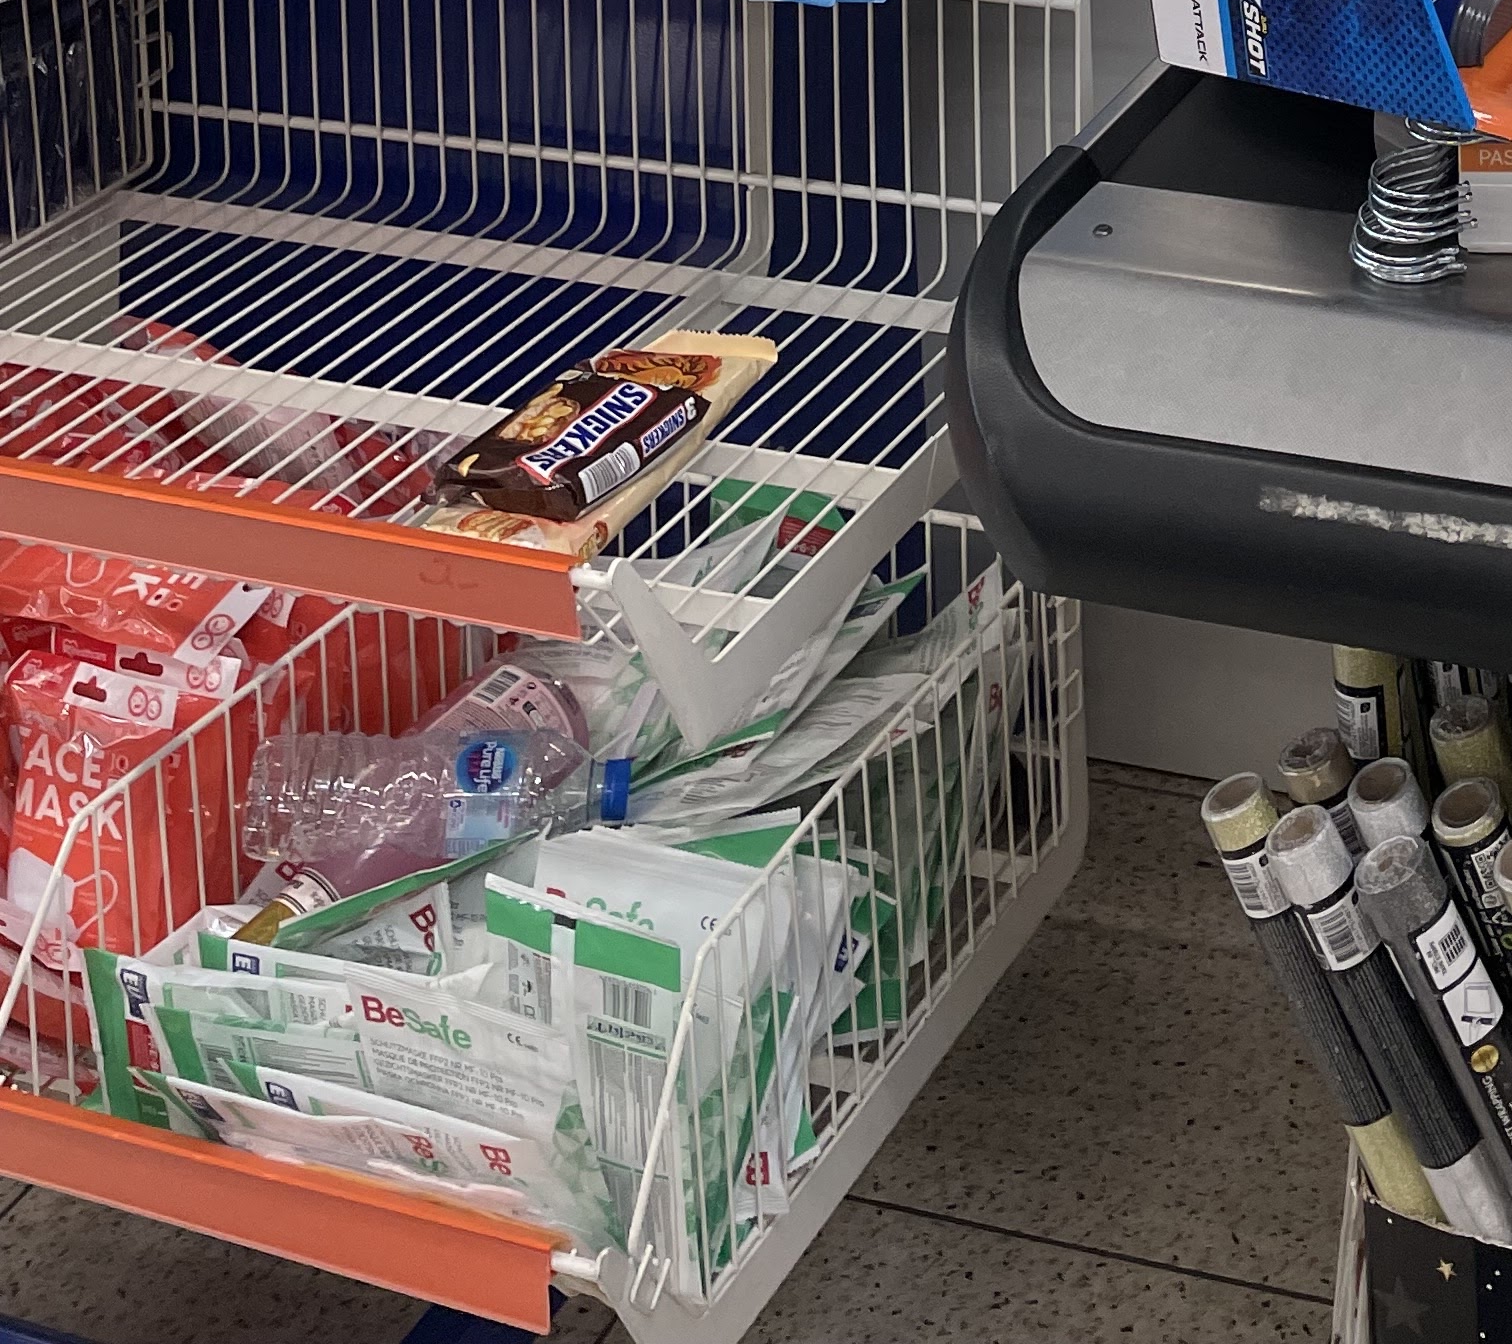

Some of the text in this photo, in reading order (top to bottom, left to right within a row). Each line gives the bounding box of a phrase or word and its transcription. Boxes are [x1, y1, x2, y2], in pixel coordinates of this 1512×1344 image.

[525, 383, 648, 472] SNICKERS
[643, 410, 684, 453] SNICKERS
[473, 740, 498, 794] Pure Life
[360, 994, 472, 1050] BeSafe
[1482, 1075, 1511, 1127] WRAPPING
